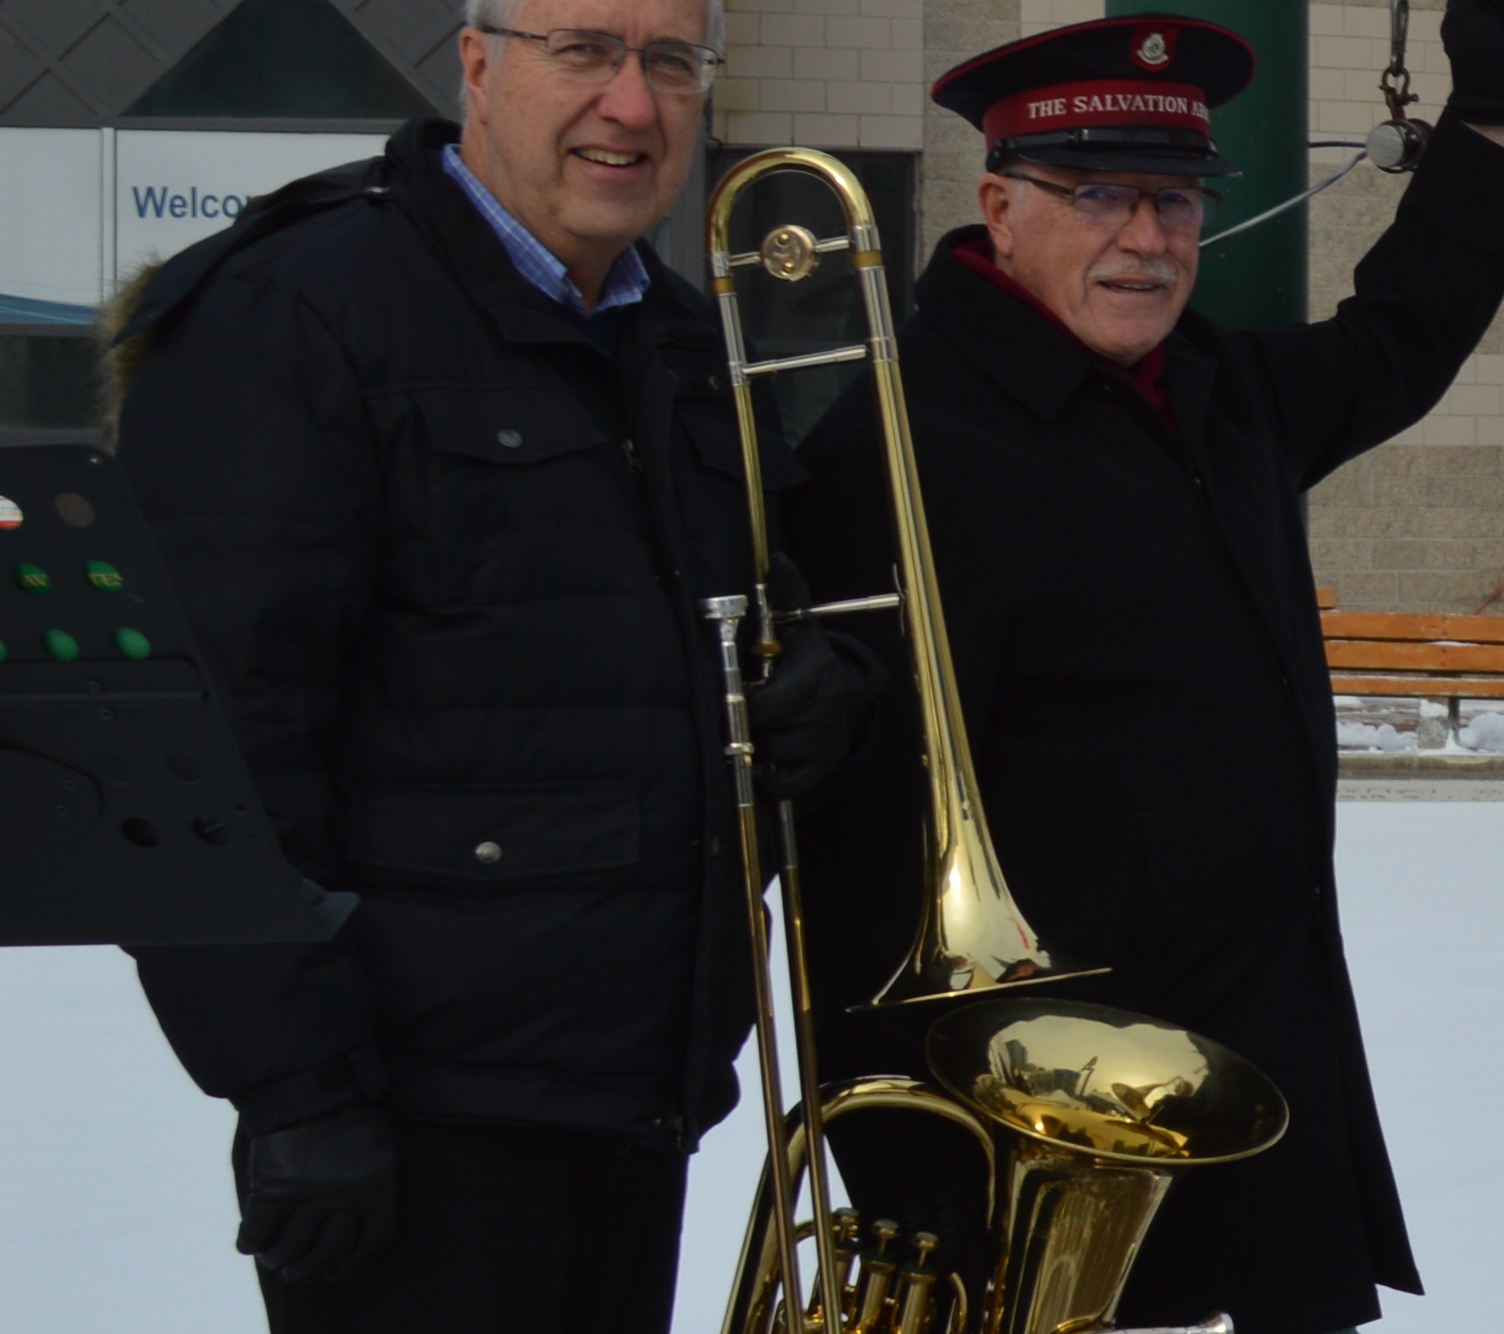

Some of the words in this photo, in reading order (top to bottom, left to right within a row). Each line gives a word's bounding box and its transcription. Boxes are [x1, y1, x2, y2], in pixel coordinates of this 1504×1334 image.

[1027, 98, 1067, 119] THE
[1073, 94, 1187, 114] SALVATION
[132, 186, 252, 219] Welco
